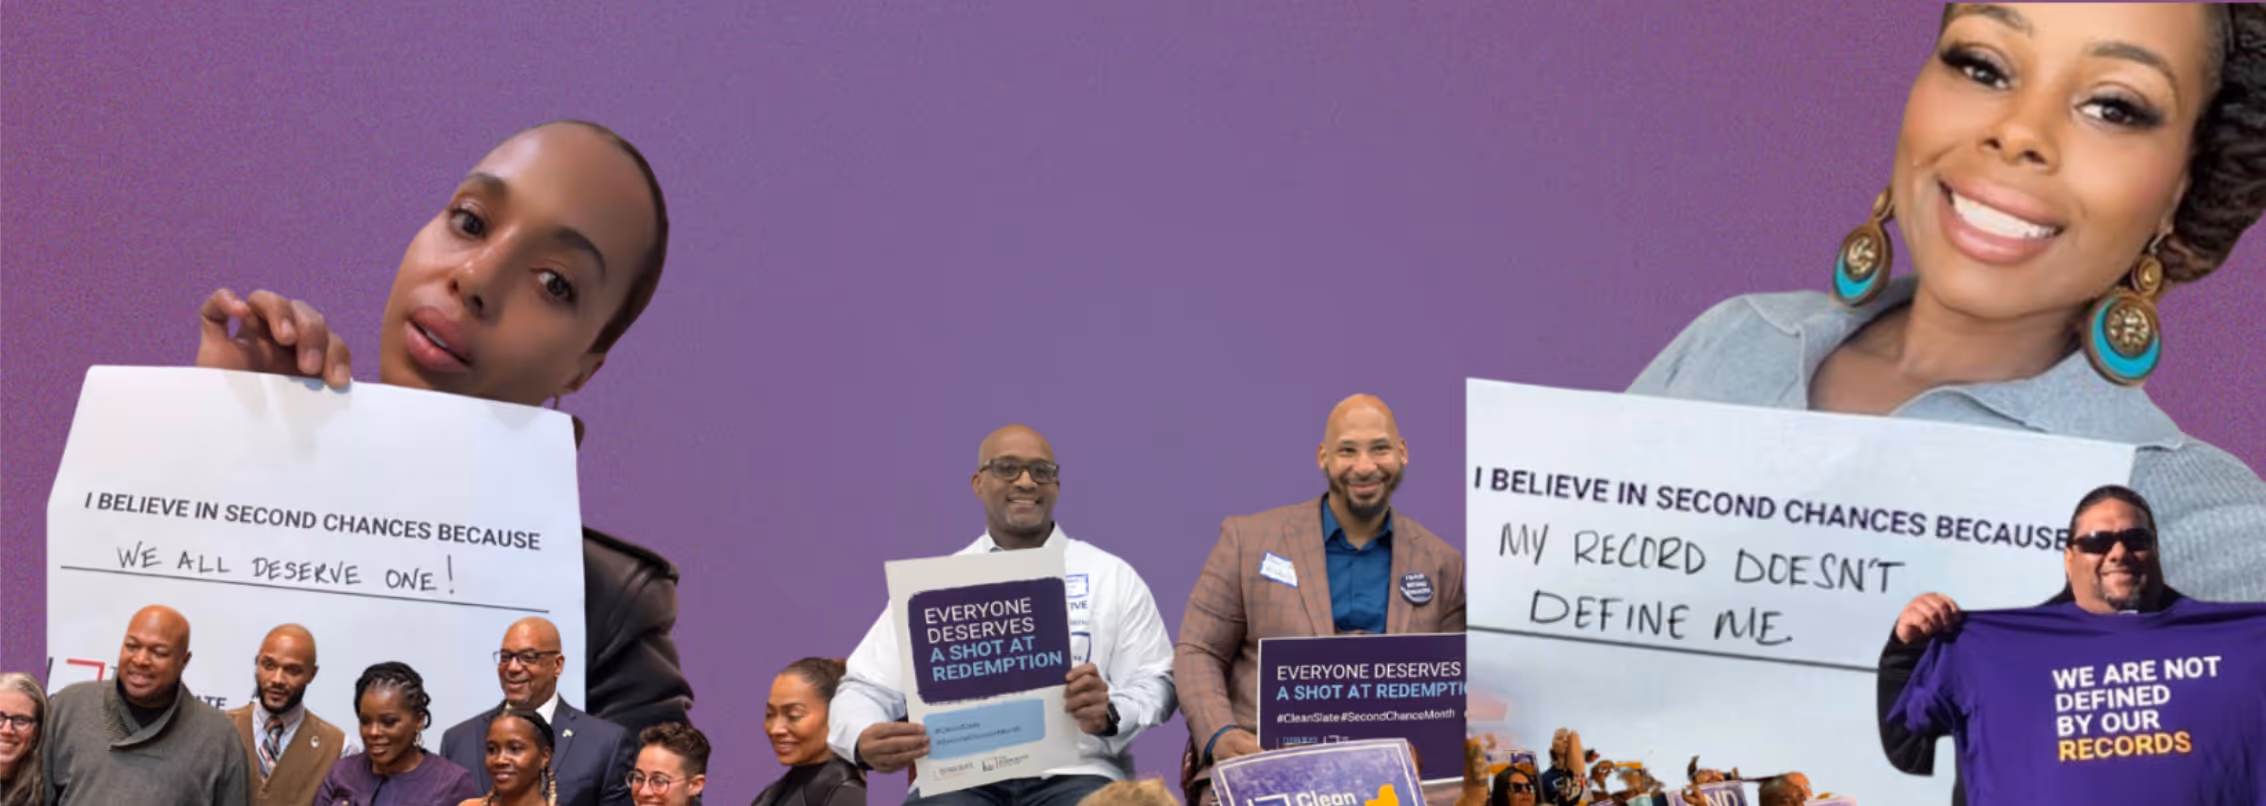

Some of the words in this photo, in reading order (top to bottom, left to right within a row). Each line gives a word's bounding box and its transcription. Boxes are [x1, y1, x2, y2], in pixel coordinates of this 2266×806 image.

[84, 492, 92, 509] I
[97, 492, 190, 518] BELIEVE
[194, 501, 219, 520] IN
[224, 504, 317, 530] SECOND
[323, 513, 432, 540] CHANCES
[437, 523, 542, 551] BECAUSE
[1474, 466, 1482, 489] I
[1491, 468, 1609, 503] BELIEVE
[1618, 481, 1647, 506] IN
[1656, 485, 1776, 520] SECOND
[1784, 499, 1926, 537] CHANCES
[1936, 515, 2070, 551] BECAUSE
[117, 540, 162, 569] WE
[177, 551, 232, 574] ALL
[252, 557, 361, 585] DESERVE
[1499, 522, 1549, 565] MY
[1574, 530, 1707, 575] RECORD
[1735, 548, 1905, 593] DOESN'T
[924, 597, 1033, 625] EVERYONE
[1530, 589, 1690, 640] DEFINE
[927, 617, 1035, 644] DESERVES
[930, 648, 945, 663] A
[950, 639, 1004, 660] SHOT
[1010, 635, 1036, 652] AT
[932, 651, 1063, 682] REDEMPTION
[1276, 663, 1369, 681] EVERYONE
[1374, 661, 1461, 678] DESERVES
[2052, 667, 2095, 689] WE
[2103, 660, 2157, 685] ARE
[2164, 655, 2222, 679] NOT
[1276, 685, 1289, 701] A
[1294, 684, 1343, 700] SHOT
[1347, 684, 1372, 699] AT
[1376, 681, 1466, 698] REDEMPTI
[2055, 685, 2171, 712] DEFINED
[1277, 713, 1340, 723] #CleanSlate
[1341, 709, 1455, 722] #SecondChanceMonth
[2057, 715, 2092, 737] BY
[2101, 710, 2161, 733] OUR
[2058, 731, 2193, 762] RECORDS
